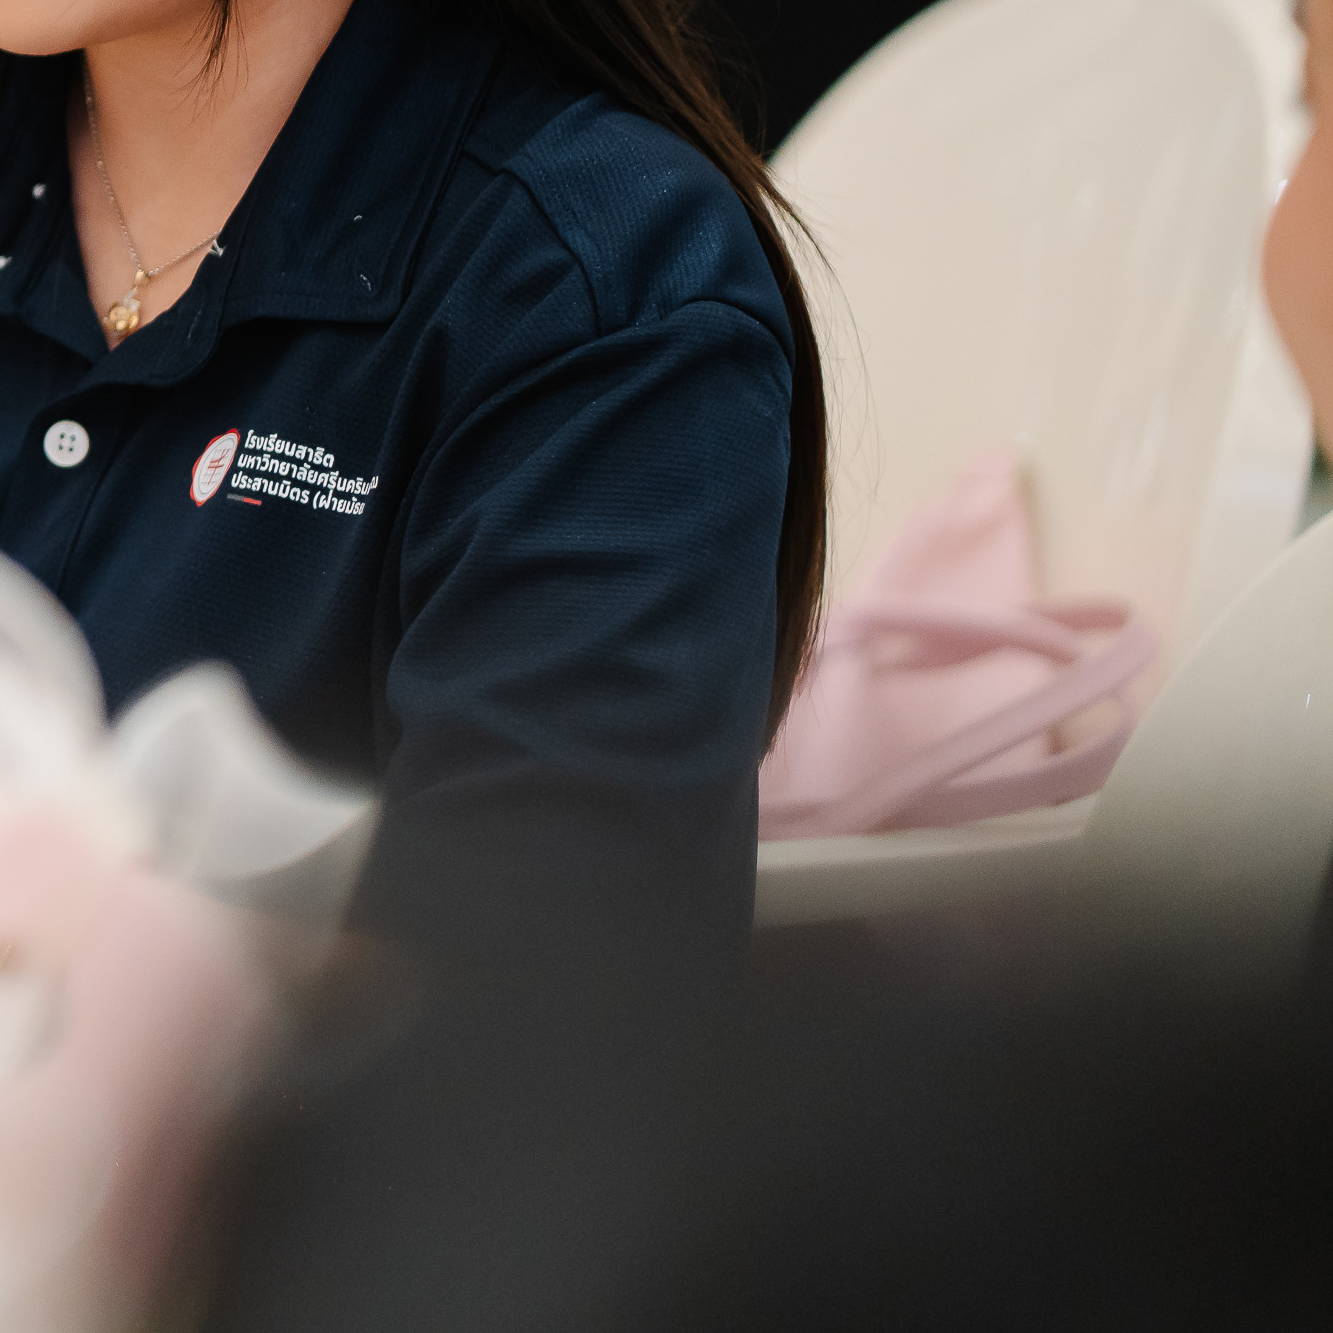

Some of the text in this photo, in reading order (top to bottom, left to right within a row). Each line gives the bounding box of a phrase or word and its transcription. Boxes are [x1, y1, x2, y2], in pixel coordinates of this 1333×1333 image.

[244, 429, 335, 469] โรงเรียนสาธิต
[231, 470, 311, 504] ประสานมิตร
